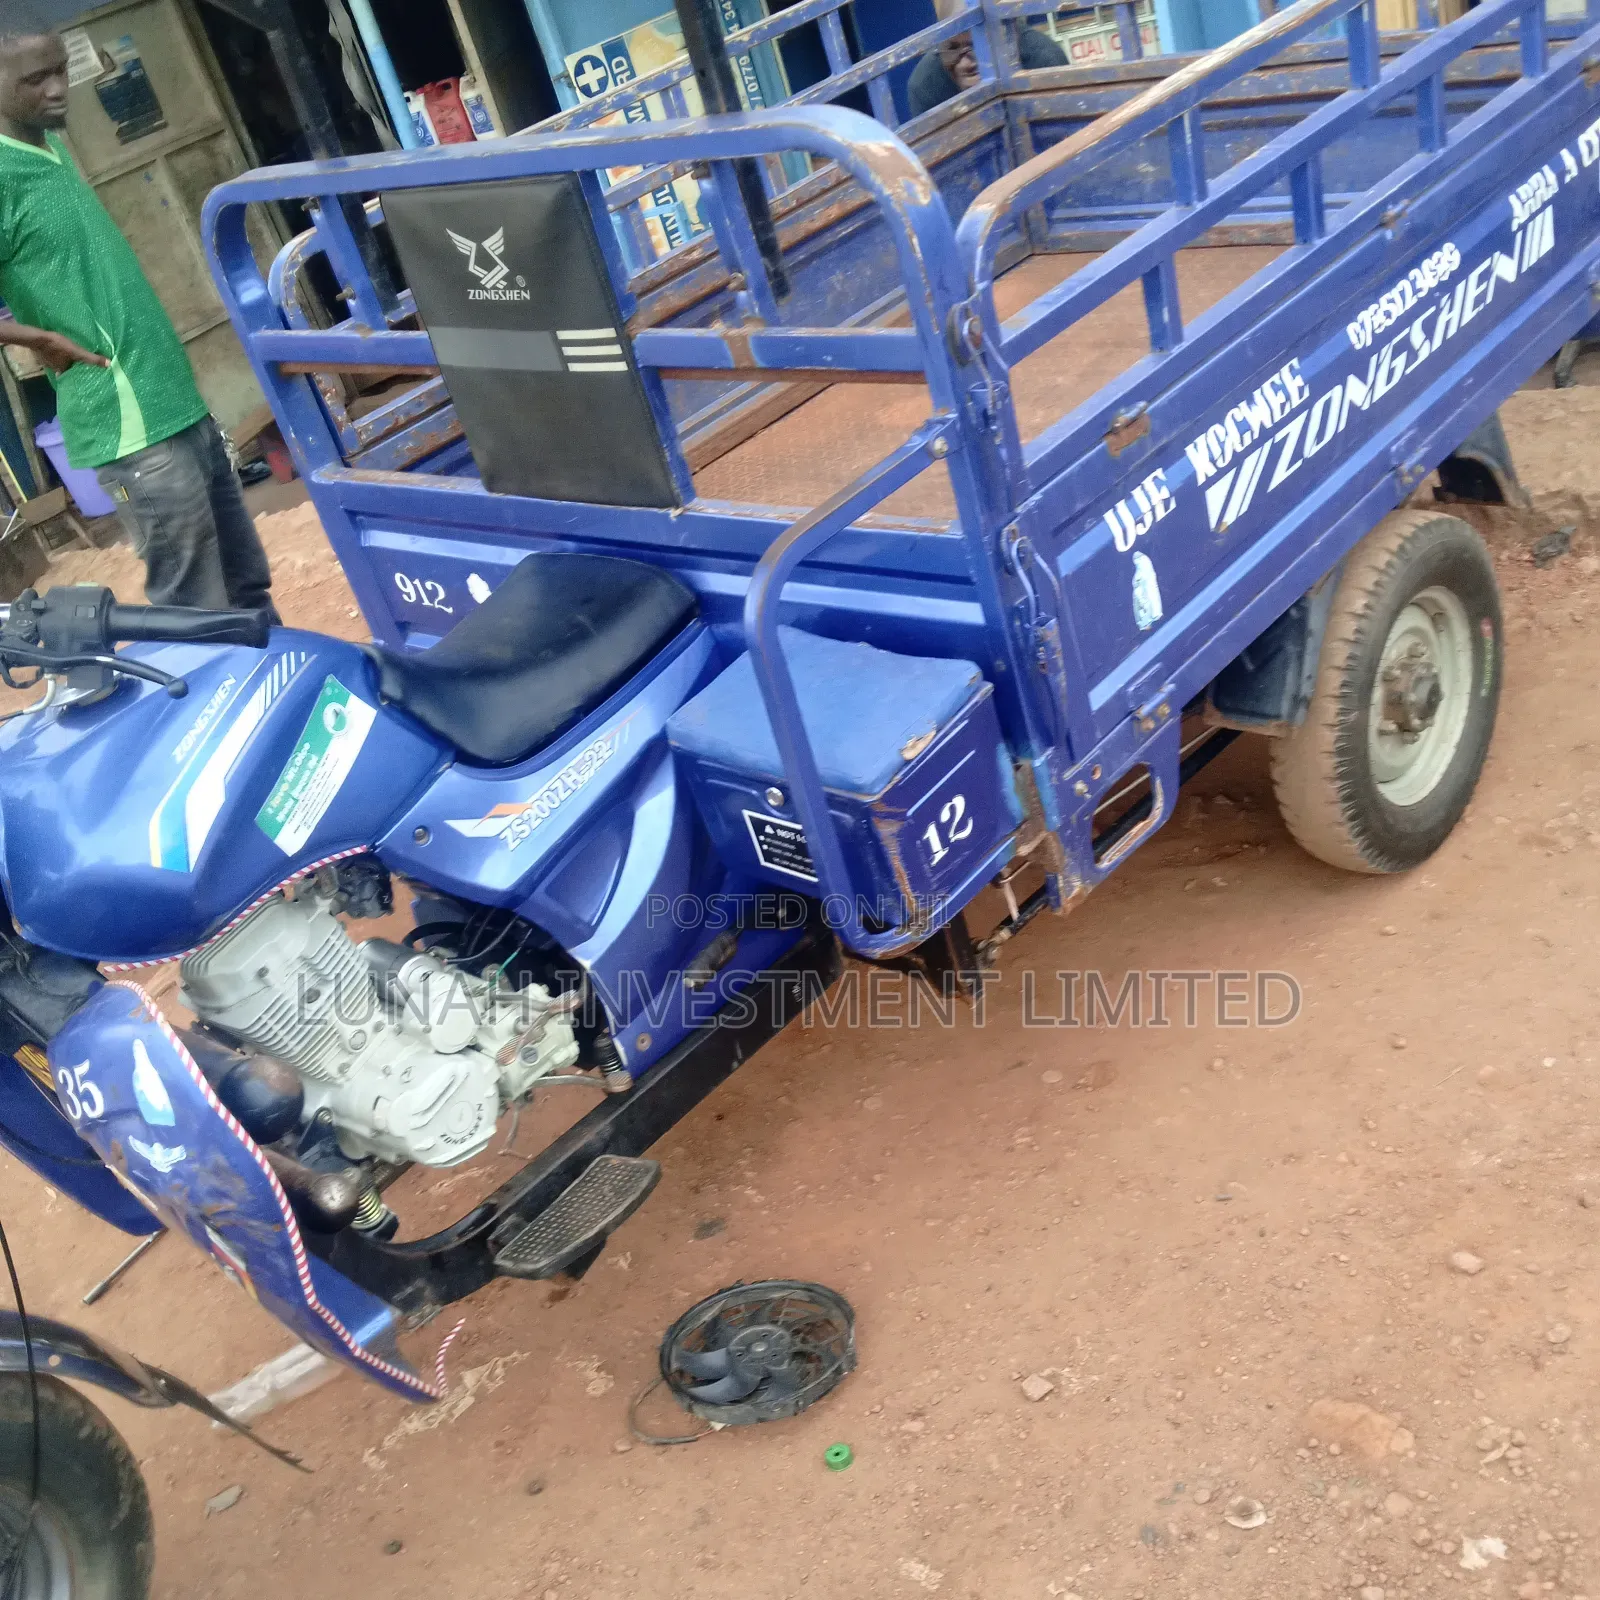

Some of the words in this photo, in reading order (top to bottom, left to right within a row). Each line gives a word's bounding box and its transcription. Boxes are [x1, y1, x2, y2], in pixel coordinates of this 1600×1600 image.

[467, 289, 531, 301] ZONGSHEN
[1266, 245, 1518, 493] ZONGSHEN
[1103, 467, 1177, 552] UJE
[394, 572, 454, 614] 912
[171, 672, 237, 764] ZONGSHEN
[922, 793, 974, 867] 12
[57, 1059, 104, 1119] 35
